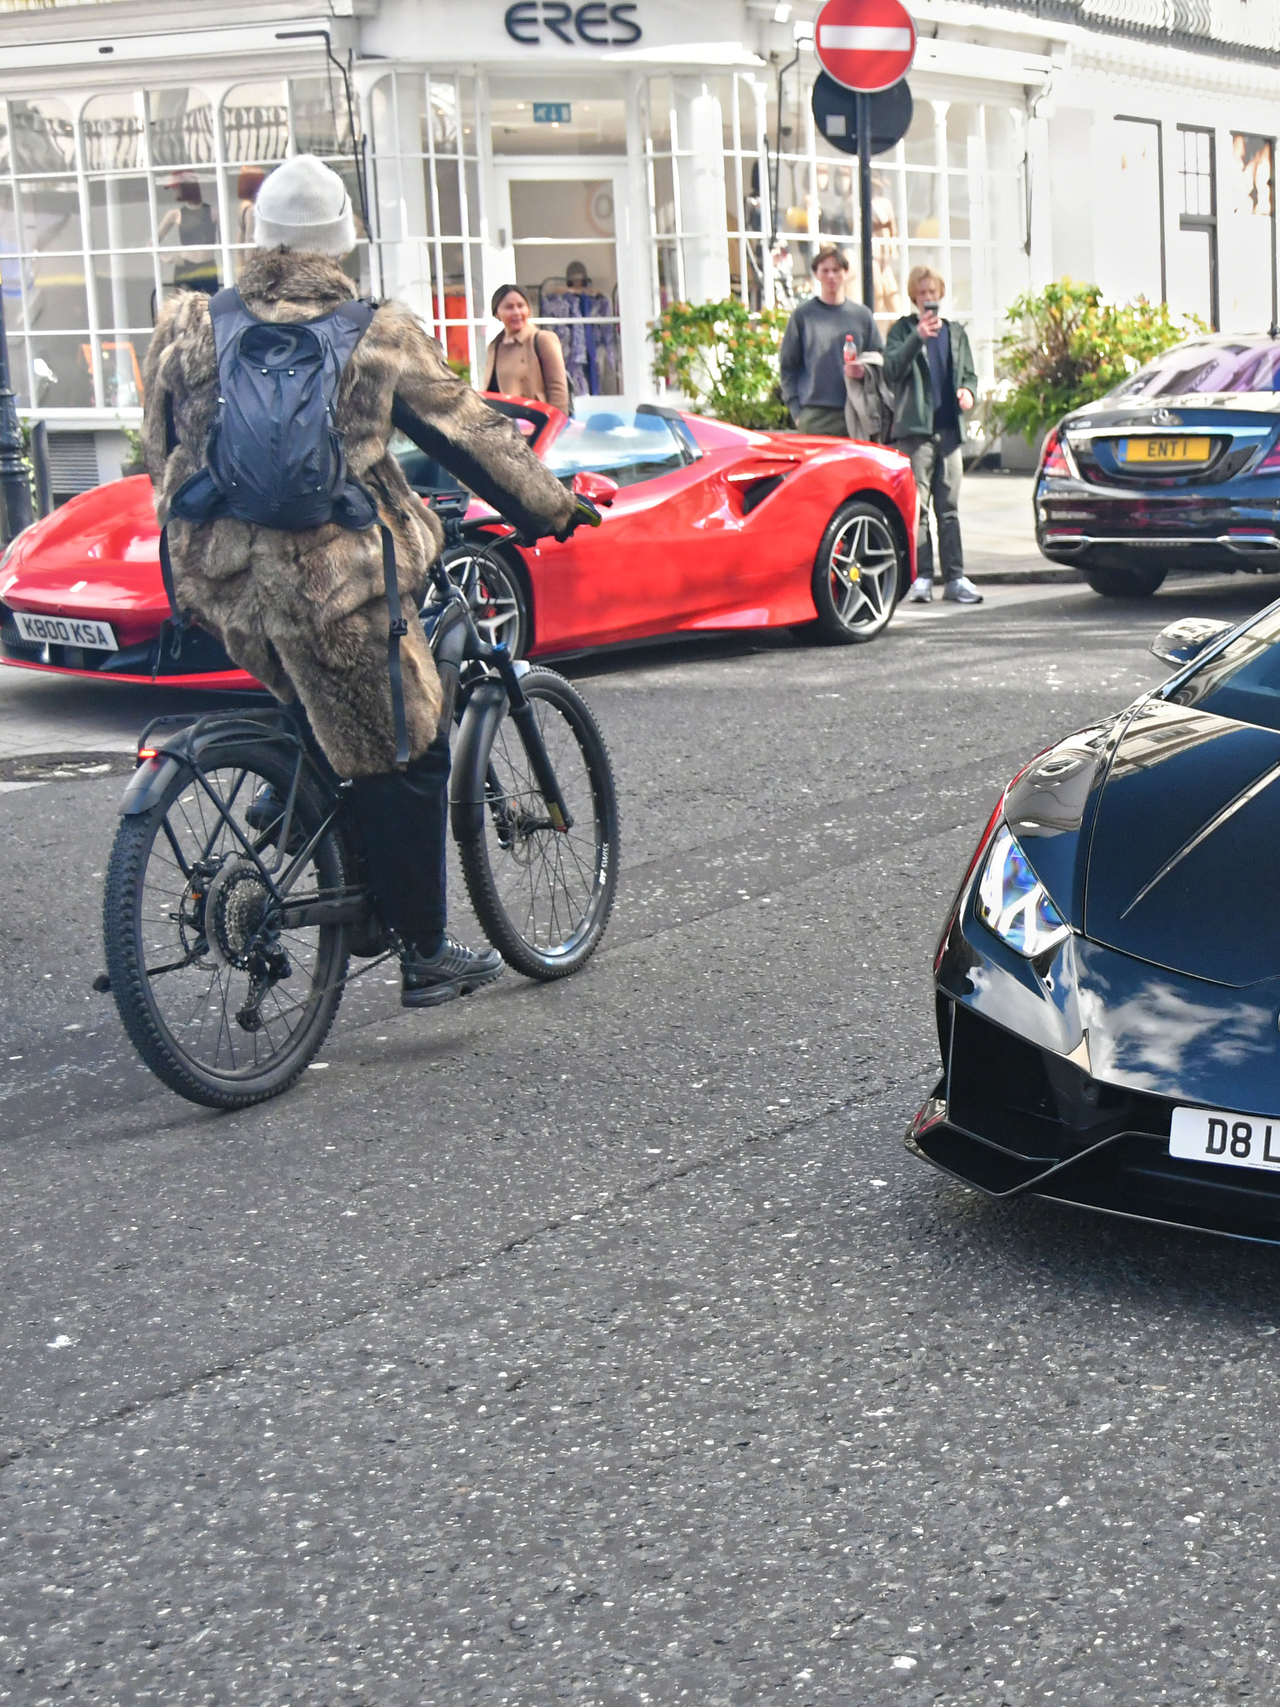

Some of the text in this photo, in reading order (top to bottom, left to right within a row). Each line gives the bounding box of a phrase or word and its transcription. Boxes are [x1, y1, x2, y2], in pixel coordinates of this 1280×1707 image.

[504, 1, 642, 46] ERES
[1148, 440, 1178, 457] ENT
[70, 622, 109, 646] KSA
[601, 842, 609, 868] SWISS
[1205, 1117, 1253, 1159] D8
